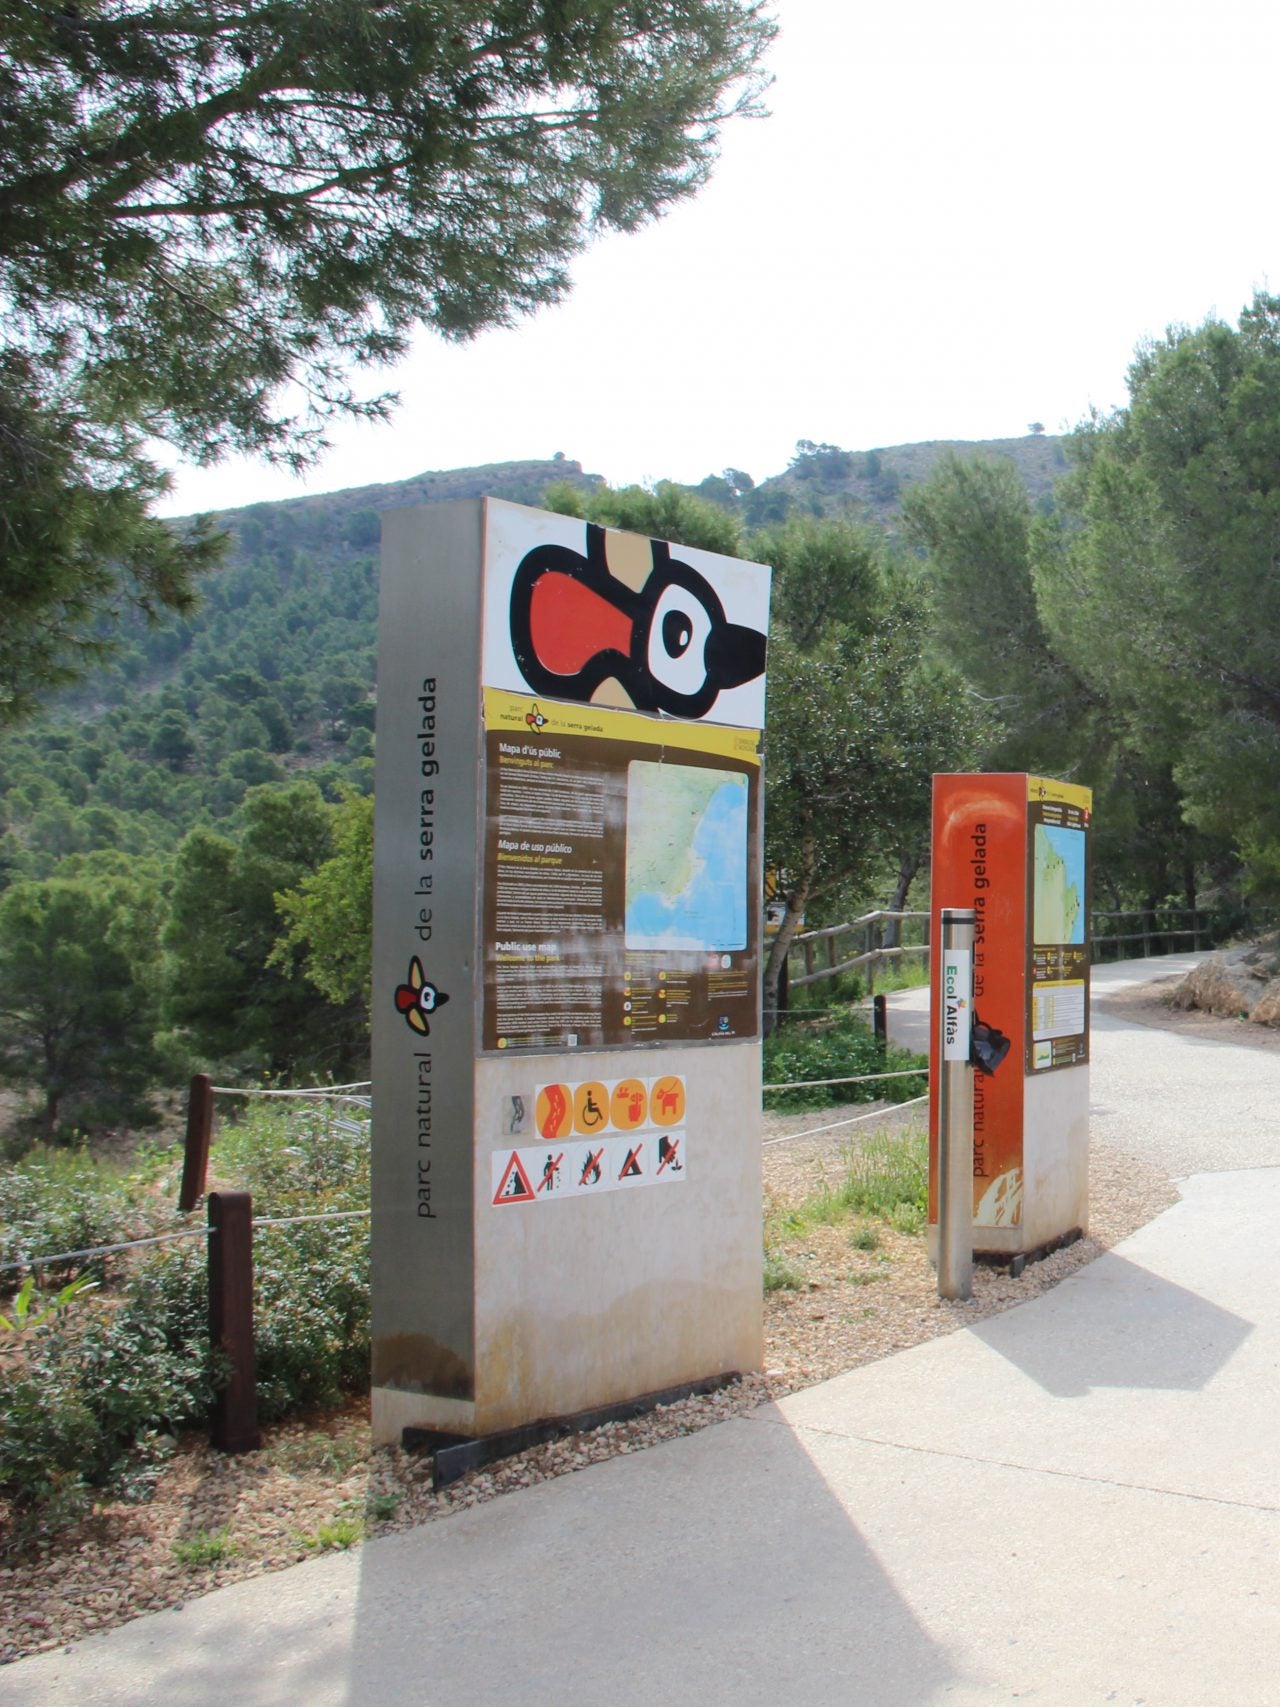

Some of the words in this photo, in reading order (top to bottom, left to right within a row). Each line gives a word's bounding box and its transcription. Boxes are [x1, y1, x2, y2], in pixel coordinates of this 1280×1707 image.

[417, 677, 439, 777] gelada
[567, 721, 583, 730] serra
[499, 742, 520, 755] Mapa
[522, 744, 538, 756] d'ús
[538, 746, 562, 759] públic
[420, 789, 435, 861] serra
[497, 840, 519, 851] Mapa
[520, 841, 530, 851] de
[531, 843, 544, 852] uso
[545, 843, 573, 854] público
[970, 823, 990, 889] gelada
[414, 874, 433, 895] la
[414, 908, 433, 941] de
[973, 896, 986, 945] serra
[495, 941, 521, 951] Public
[522, 943, 537, 951] use
[538, 944, 558, 954] map
[946, 965, 958, 1000] Ecol
[945, 1005, 958, 1045] Alfàs
[413, 1052, 432, 1148] natural
[973, 1138, 990, 1178] parc
[417, 1159, 437, 1219] parc
